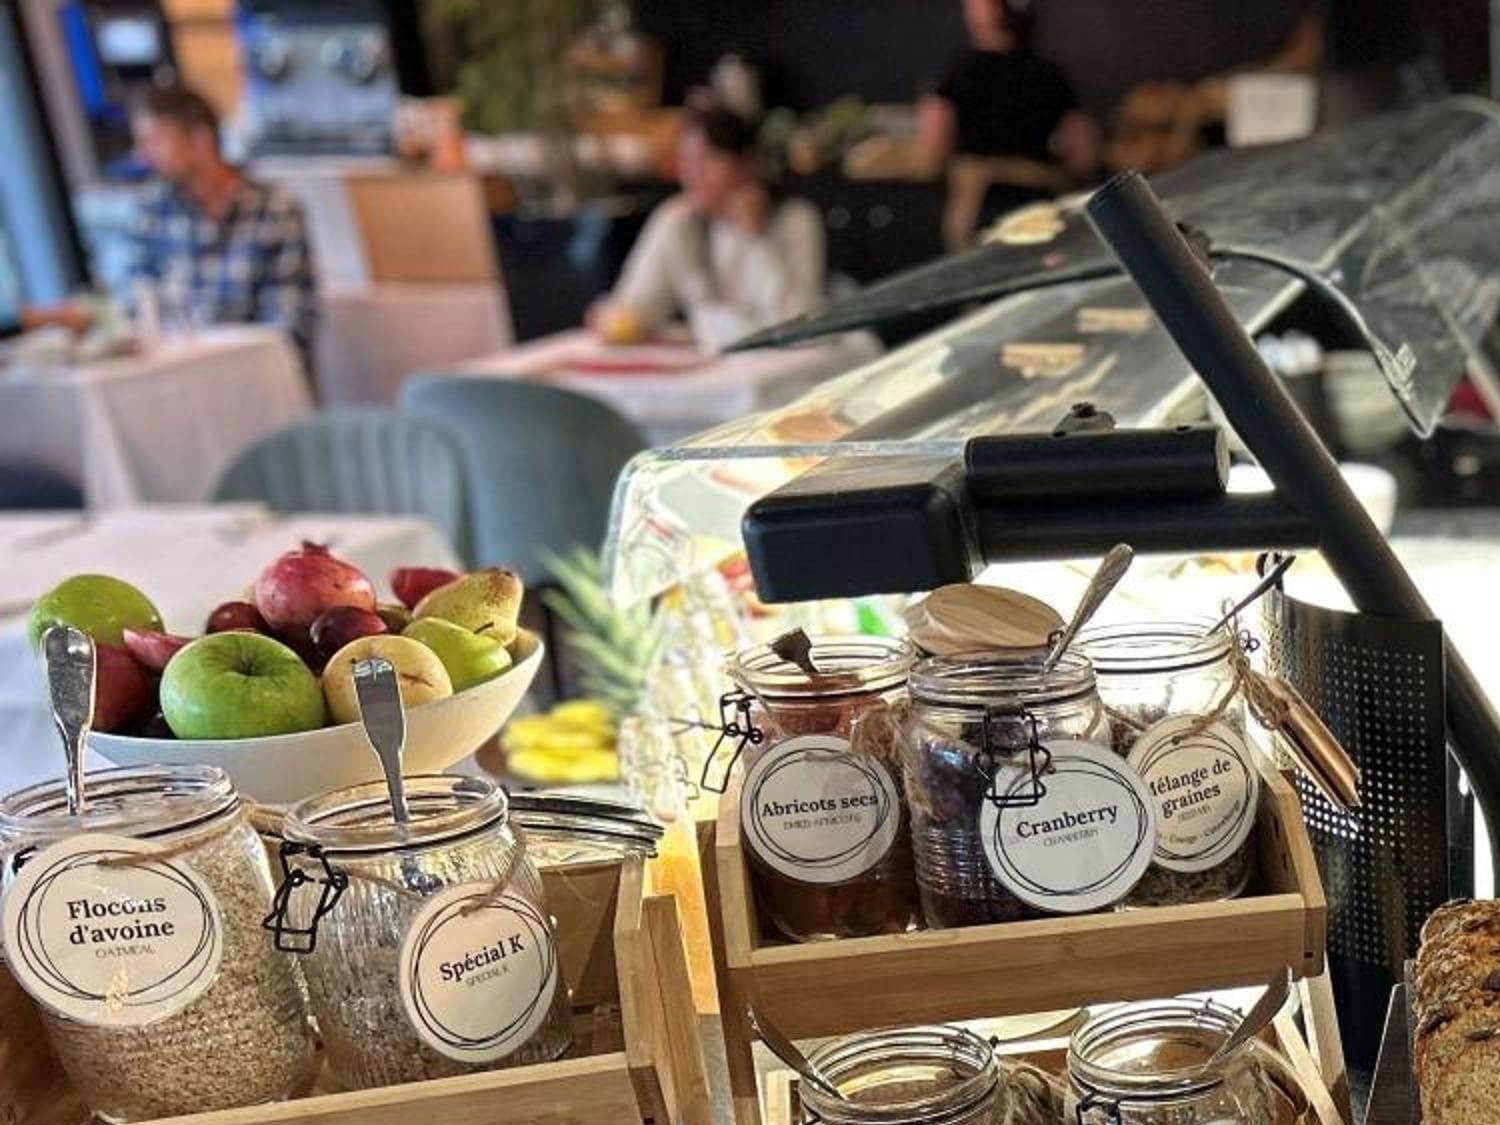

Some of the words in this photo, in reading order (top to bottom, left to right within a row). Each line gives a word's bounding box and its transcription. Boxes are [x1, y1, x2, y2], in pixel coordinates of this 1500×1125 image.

[1212, 759, 1232, 776] de
[762, 799, 837, 818] Abricots
[840, 795, 879, 809] secs
[1161, 784, 1221, 820] graines
[1016, 805, 1118, 839] Cranberry
[66, 897, 167, 920] Flocons
[69, 919, 175, 945] d'avoine
[440, 941, 506, 982] Spécial
[508, 933, 525, 955] K
